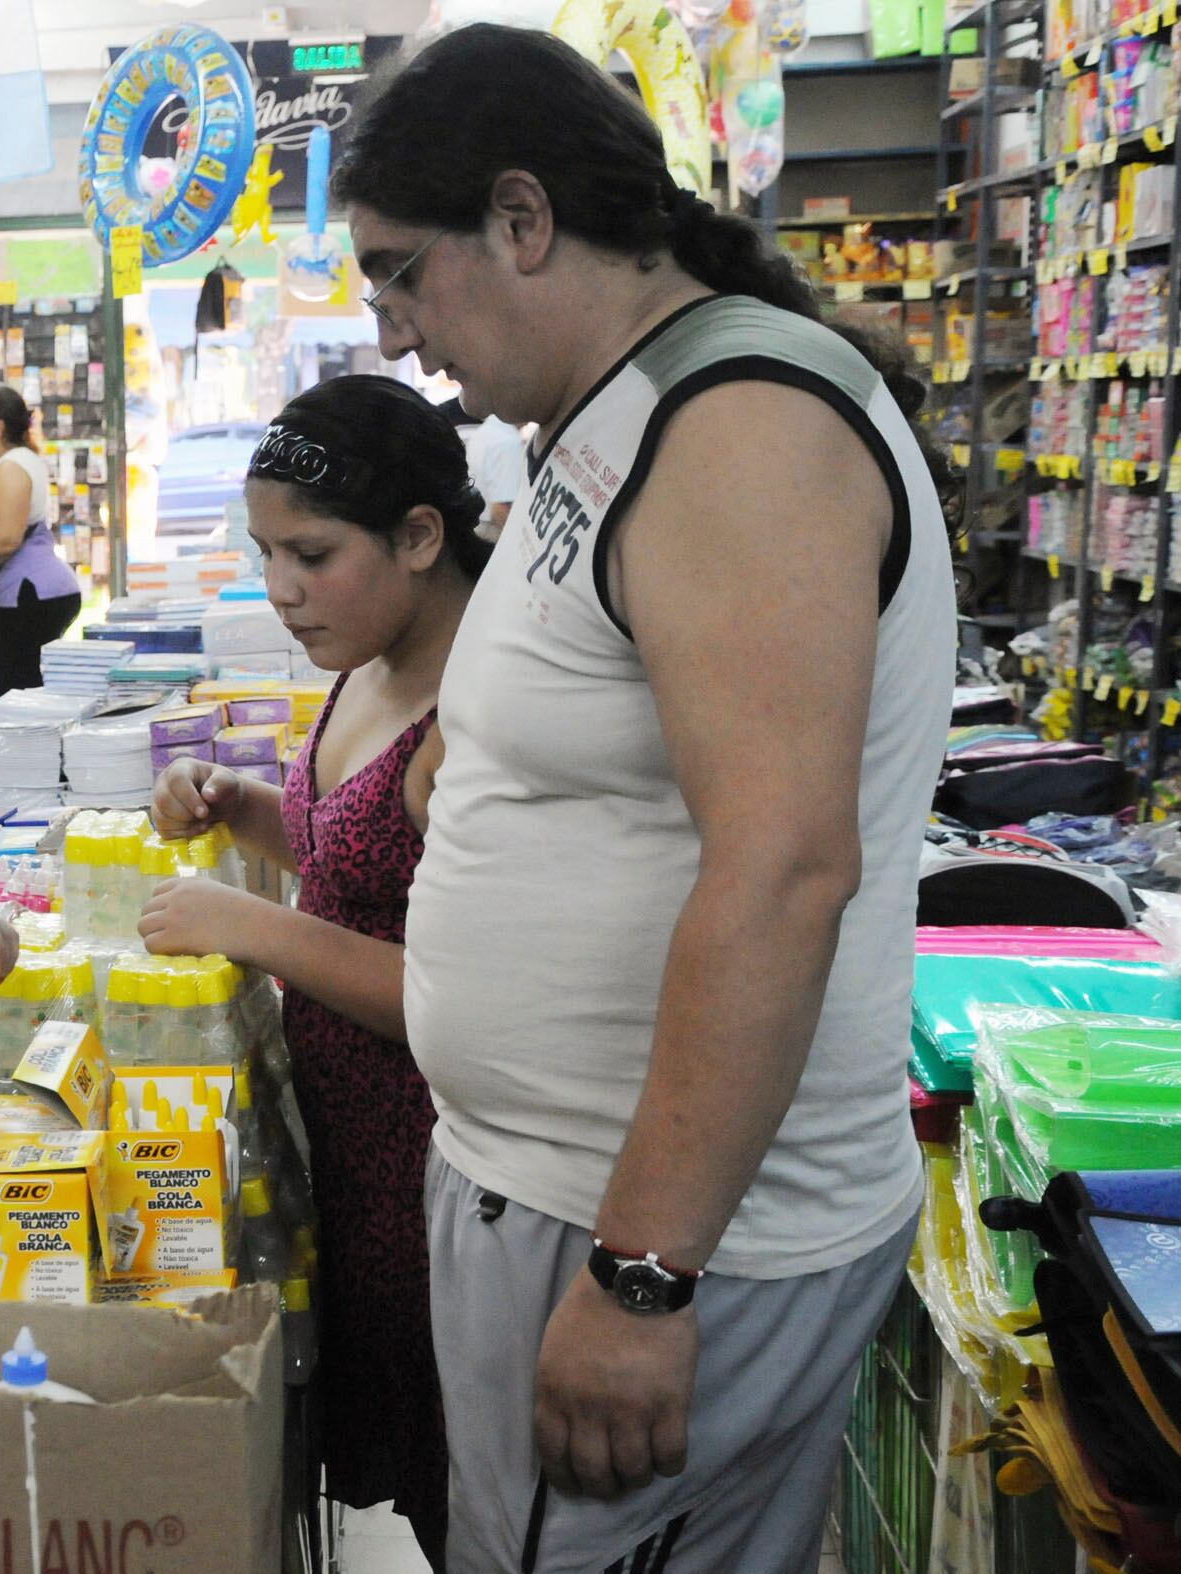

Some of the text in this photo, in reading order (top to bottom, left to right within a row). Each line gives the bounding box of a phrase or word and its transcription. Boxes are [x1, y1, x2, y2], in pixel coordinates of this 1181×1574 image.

[136, 1169, 211, 1179] PEGAMENTO
[149, 1178, 198, 1188] BLANCO
[157, 1191, 192, 1200] COLA
[148, 1200, 203, 1210] BRANCA
[8, 1211, 80, 1220] PEGAMENTO
[21, 1220, 68, 1229] BLANCO
[27, 1233, 62, 1242] COLA
[19, 1242, 71, 1251] BRANCA
